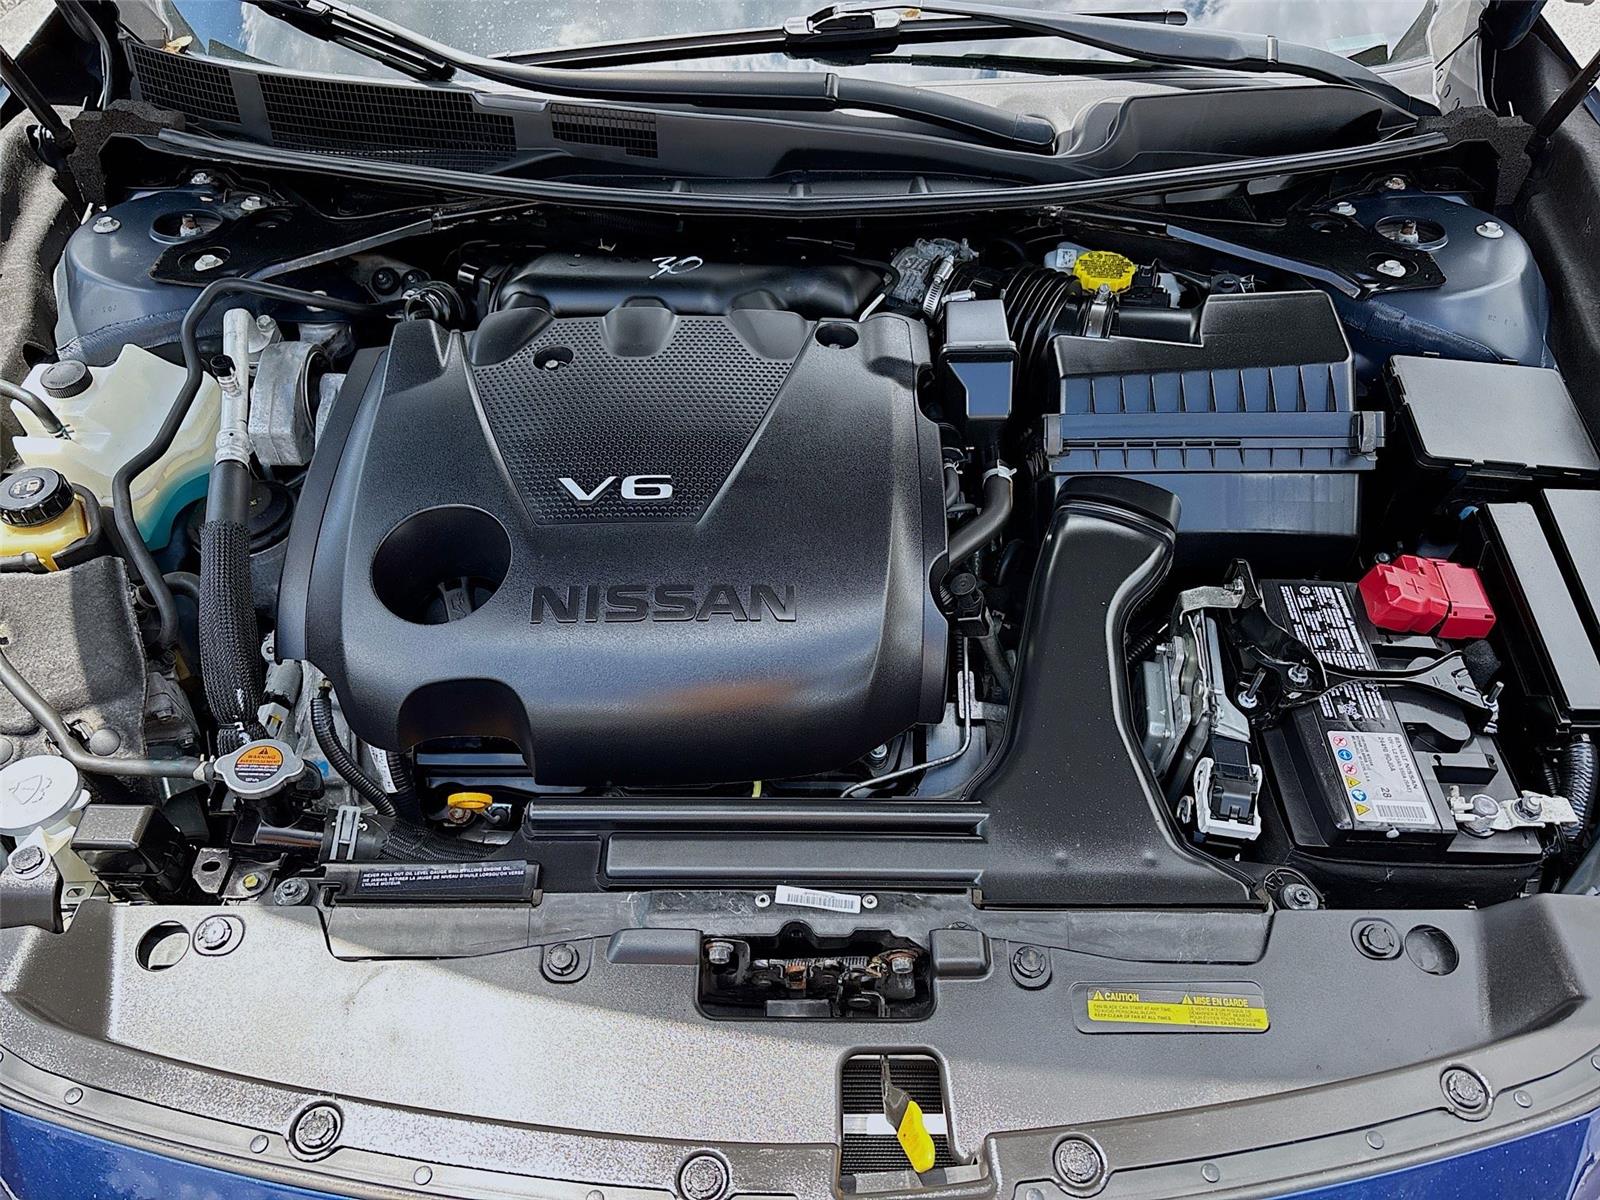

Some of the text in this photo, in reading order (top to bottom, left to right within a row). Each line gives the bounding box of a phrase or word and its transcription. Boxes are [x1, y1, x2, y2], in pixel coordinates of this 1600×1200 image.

[558, 474, 673, 501] V6
[530, 583, 796, 625] NISSAN
[1404, 763, 1418, 789] NISSAN
[1380, 786, 1392, 798] 28
[1104, 992, 1140, 1002] CAUTION
[1193, 996, 1249, 1008] MISE EN GARDE
